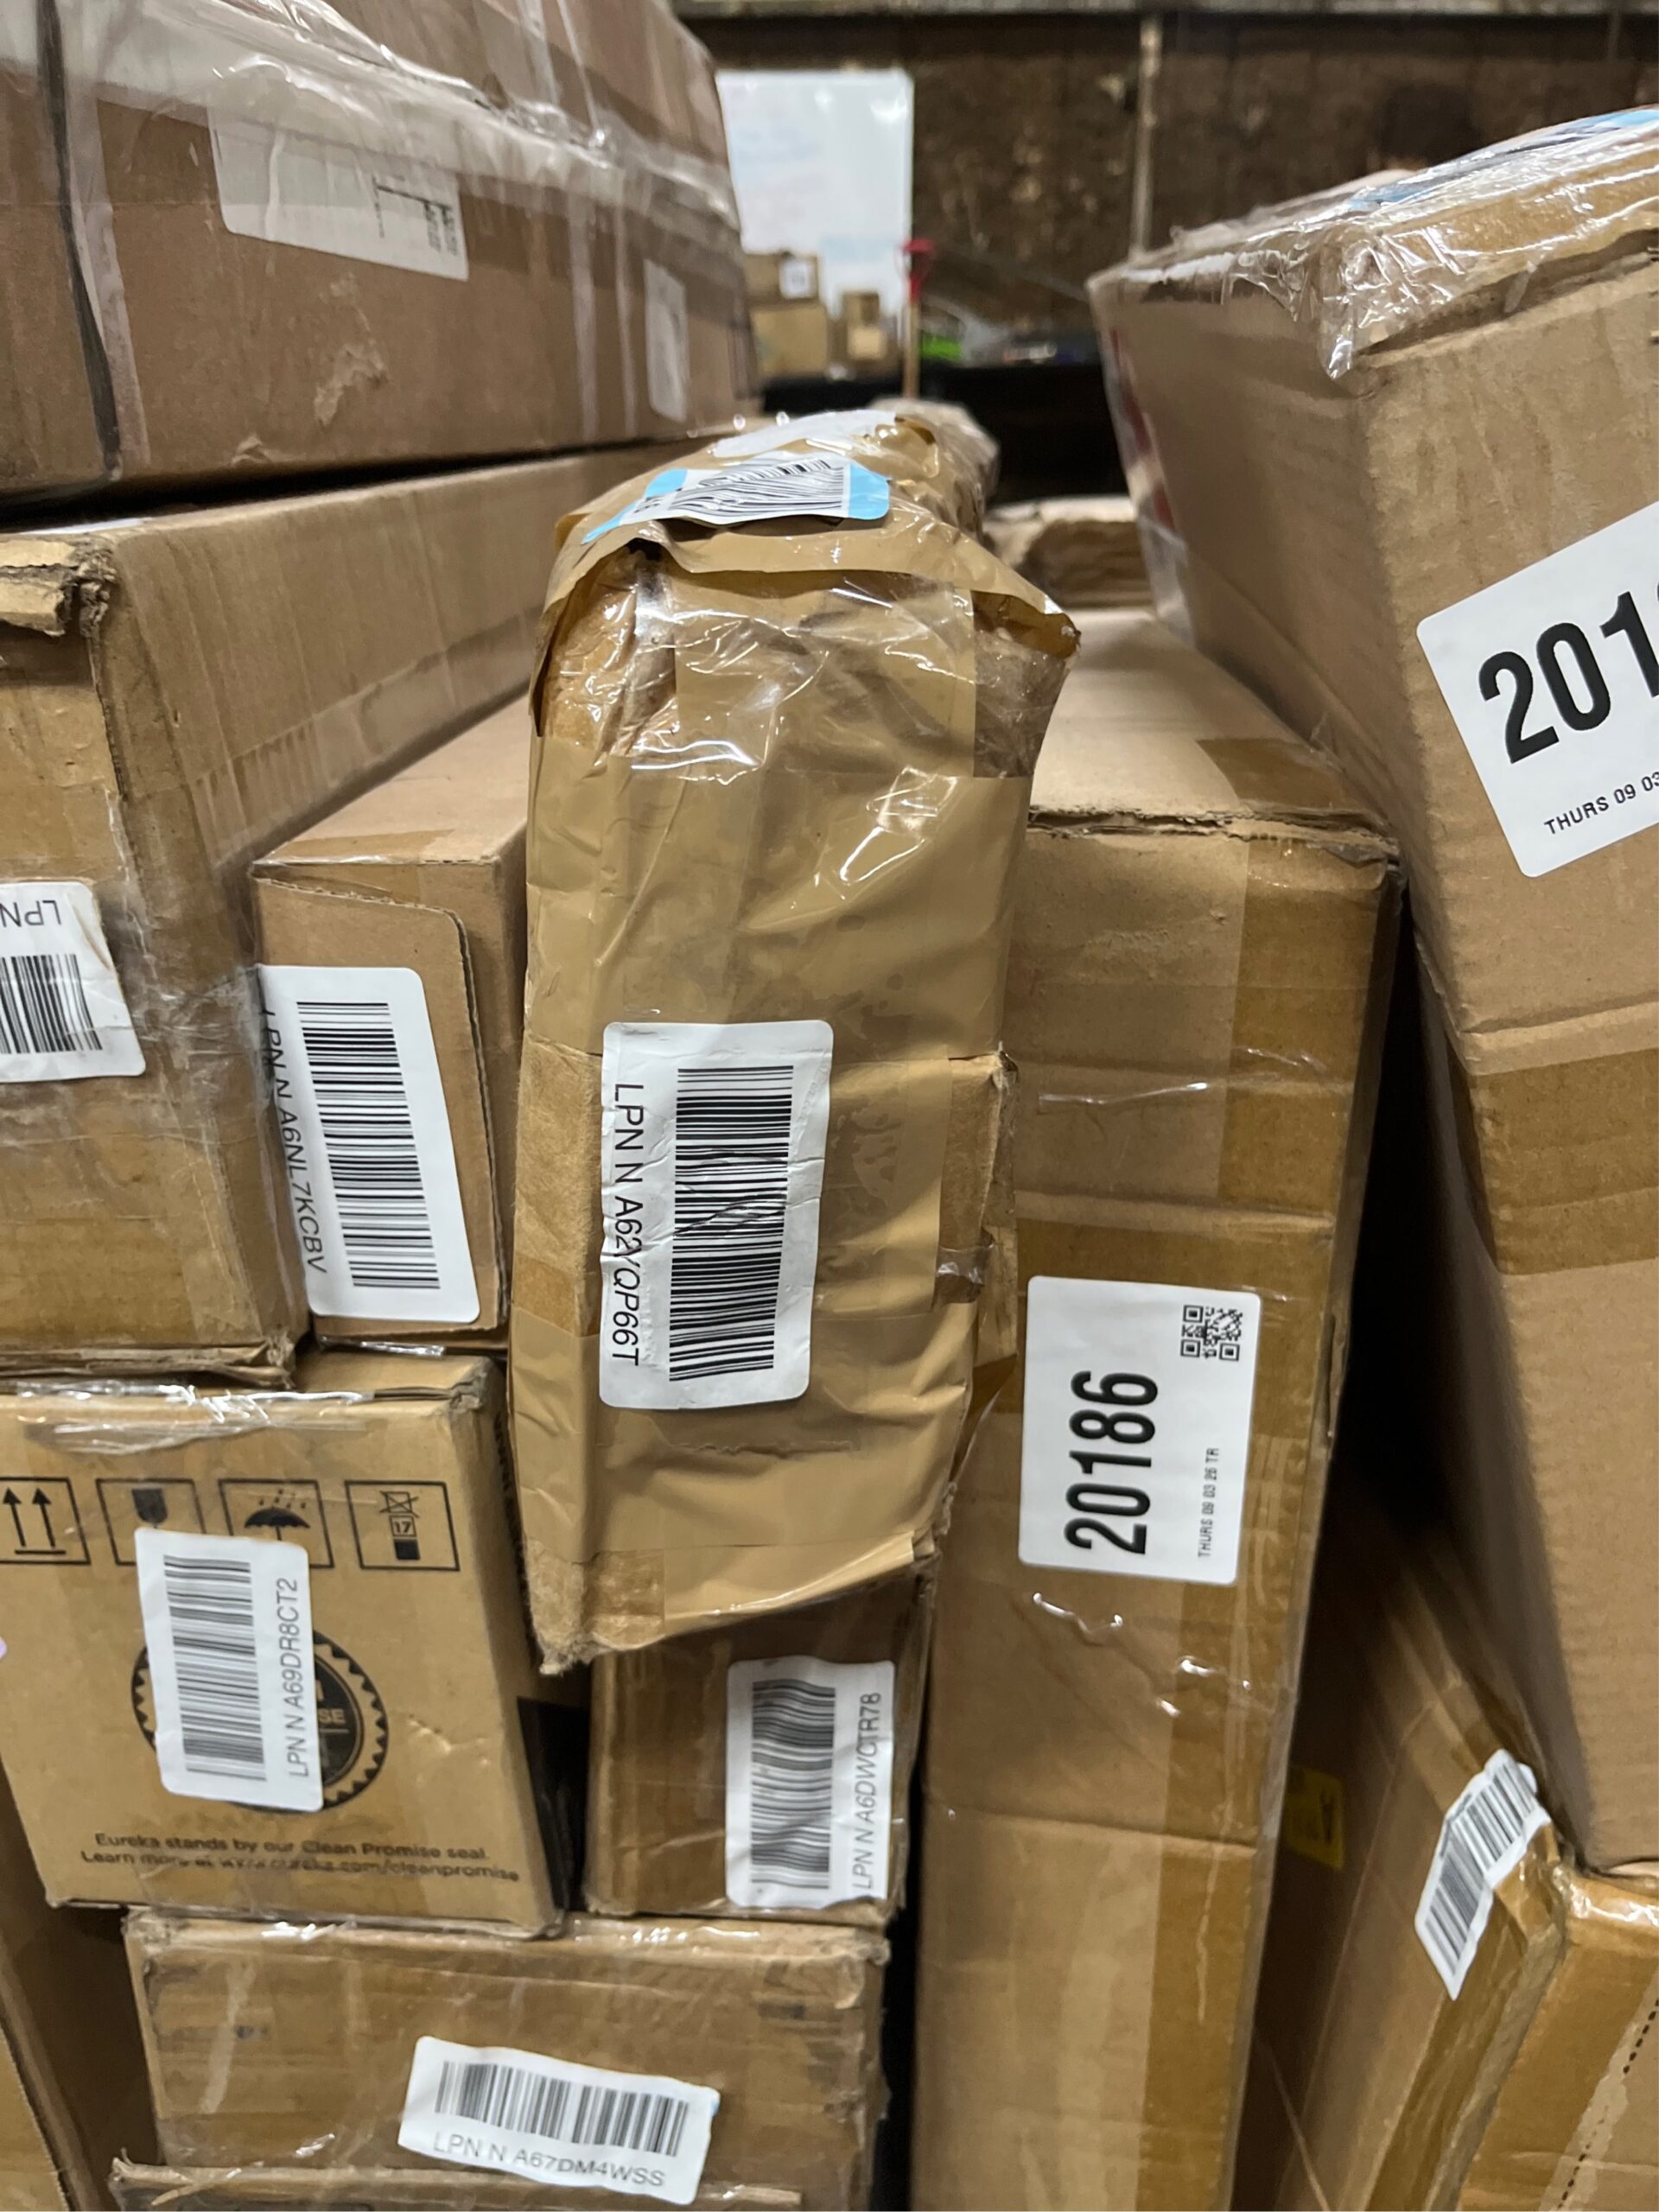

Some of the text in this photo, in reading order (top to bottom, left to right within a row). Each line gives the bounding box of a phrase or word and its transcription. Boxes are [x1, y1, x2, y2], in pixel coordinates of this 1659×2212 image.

[1478, 573, 1659, 764] 201
[1543, 796, 1610, 835] THURS
[1613, 783, 1637, 804] 09
[0, 899, 62, 928] LPN
[276, 1077, 293, 1098] N
[614, 1084, 645, 1151] LPN
[278, 1107, 328, 1274] A6NL7KCBV
[614, 1162, 645, 1184] N
[1063, 1370, 1159, 1556] 20186
[393, 1521, 412, 1534] 17
[276, 1577, 310, 1779] LPN N A69DR8CT2
[81, 1851, 135, 1865] Learn
[95, 1833, 160, 1848] Eureka
[165, 1837, 228, 1851] stands
[232, 1838, 257, 1853] by
[264, 1841, 294, 1853] our
[301, 1840, 357, 1855] Clean
[361, 1842, 441, 1859] Promise
[852, 1827, 874, 1846] N
[851, 1847, 874, 1891] LPN
[433, 2132, 666, 2188] LPN N A67DM4WSS
